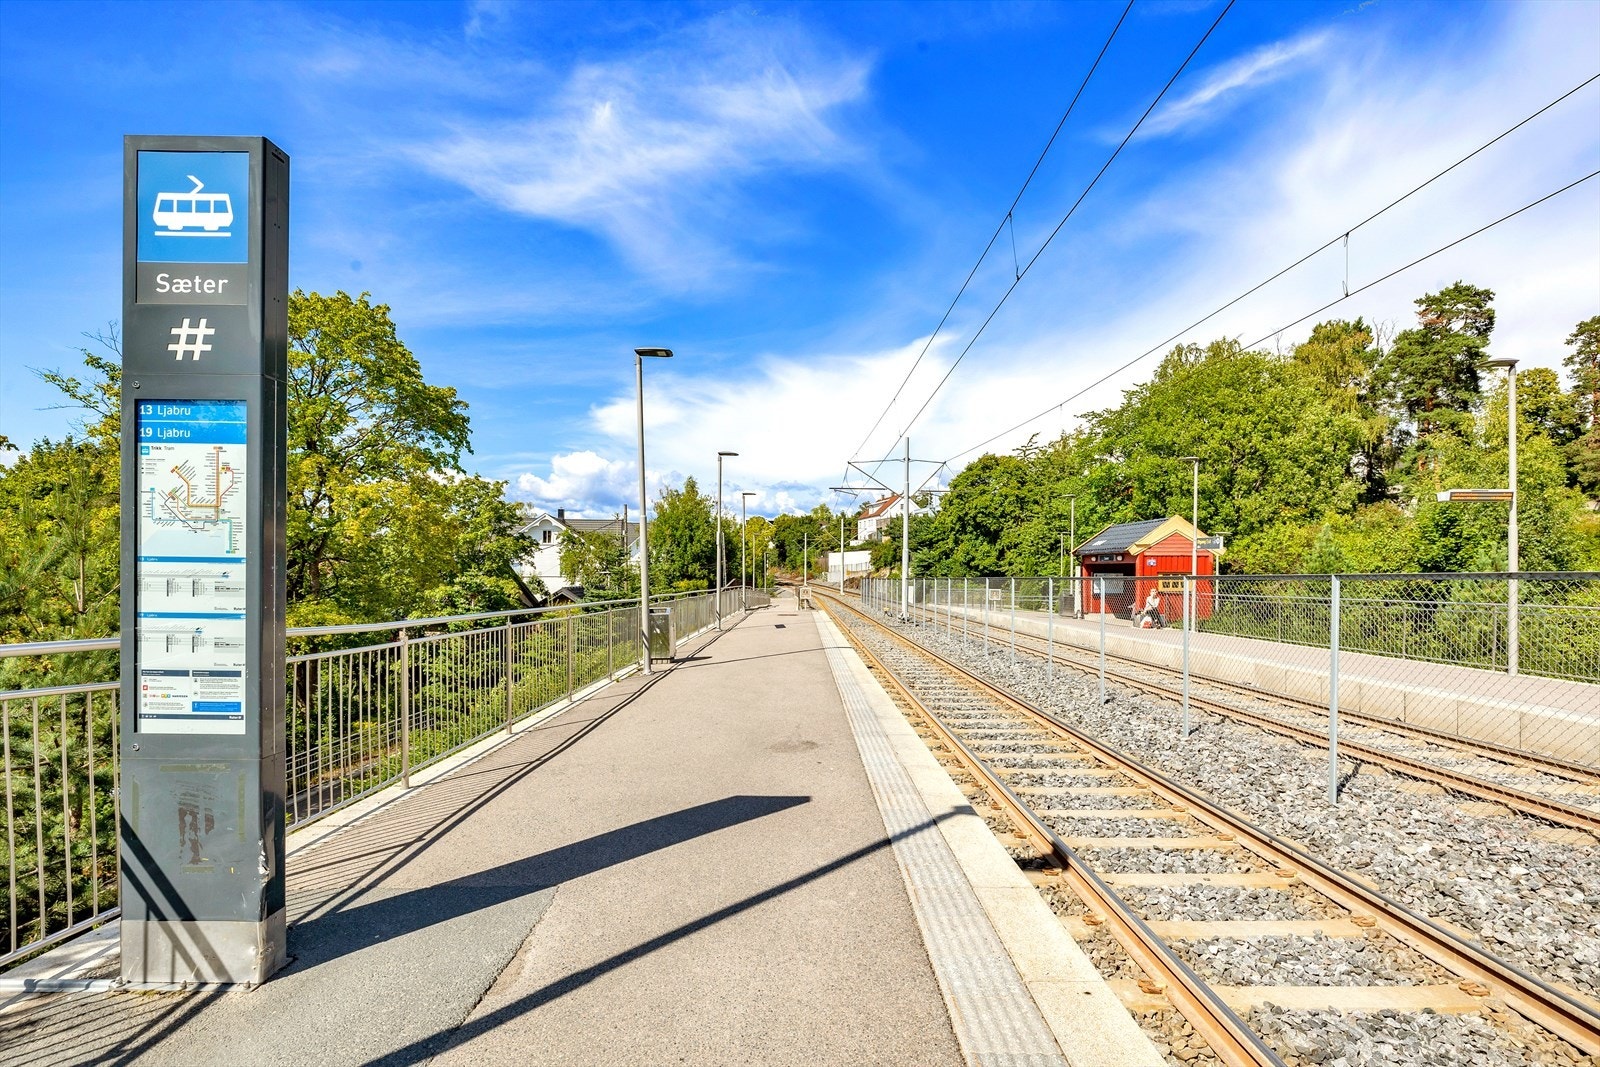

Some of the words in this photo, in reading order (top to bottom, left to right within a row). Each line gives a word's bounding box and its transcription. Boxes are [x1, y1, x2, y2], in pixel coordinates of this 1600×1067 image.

[155, 273, 229, 294] Sæter
[168, 318, 215, 361] #
[139, 405, 153, 415] 13
[157, 405, 191, 417] Ljabru
[139, 427, 153, 438] 19
[157, 427, 191, 439] Ljabru
